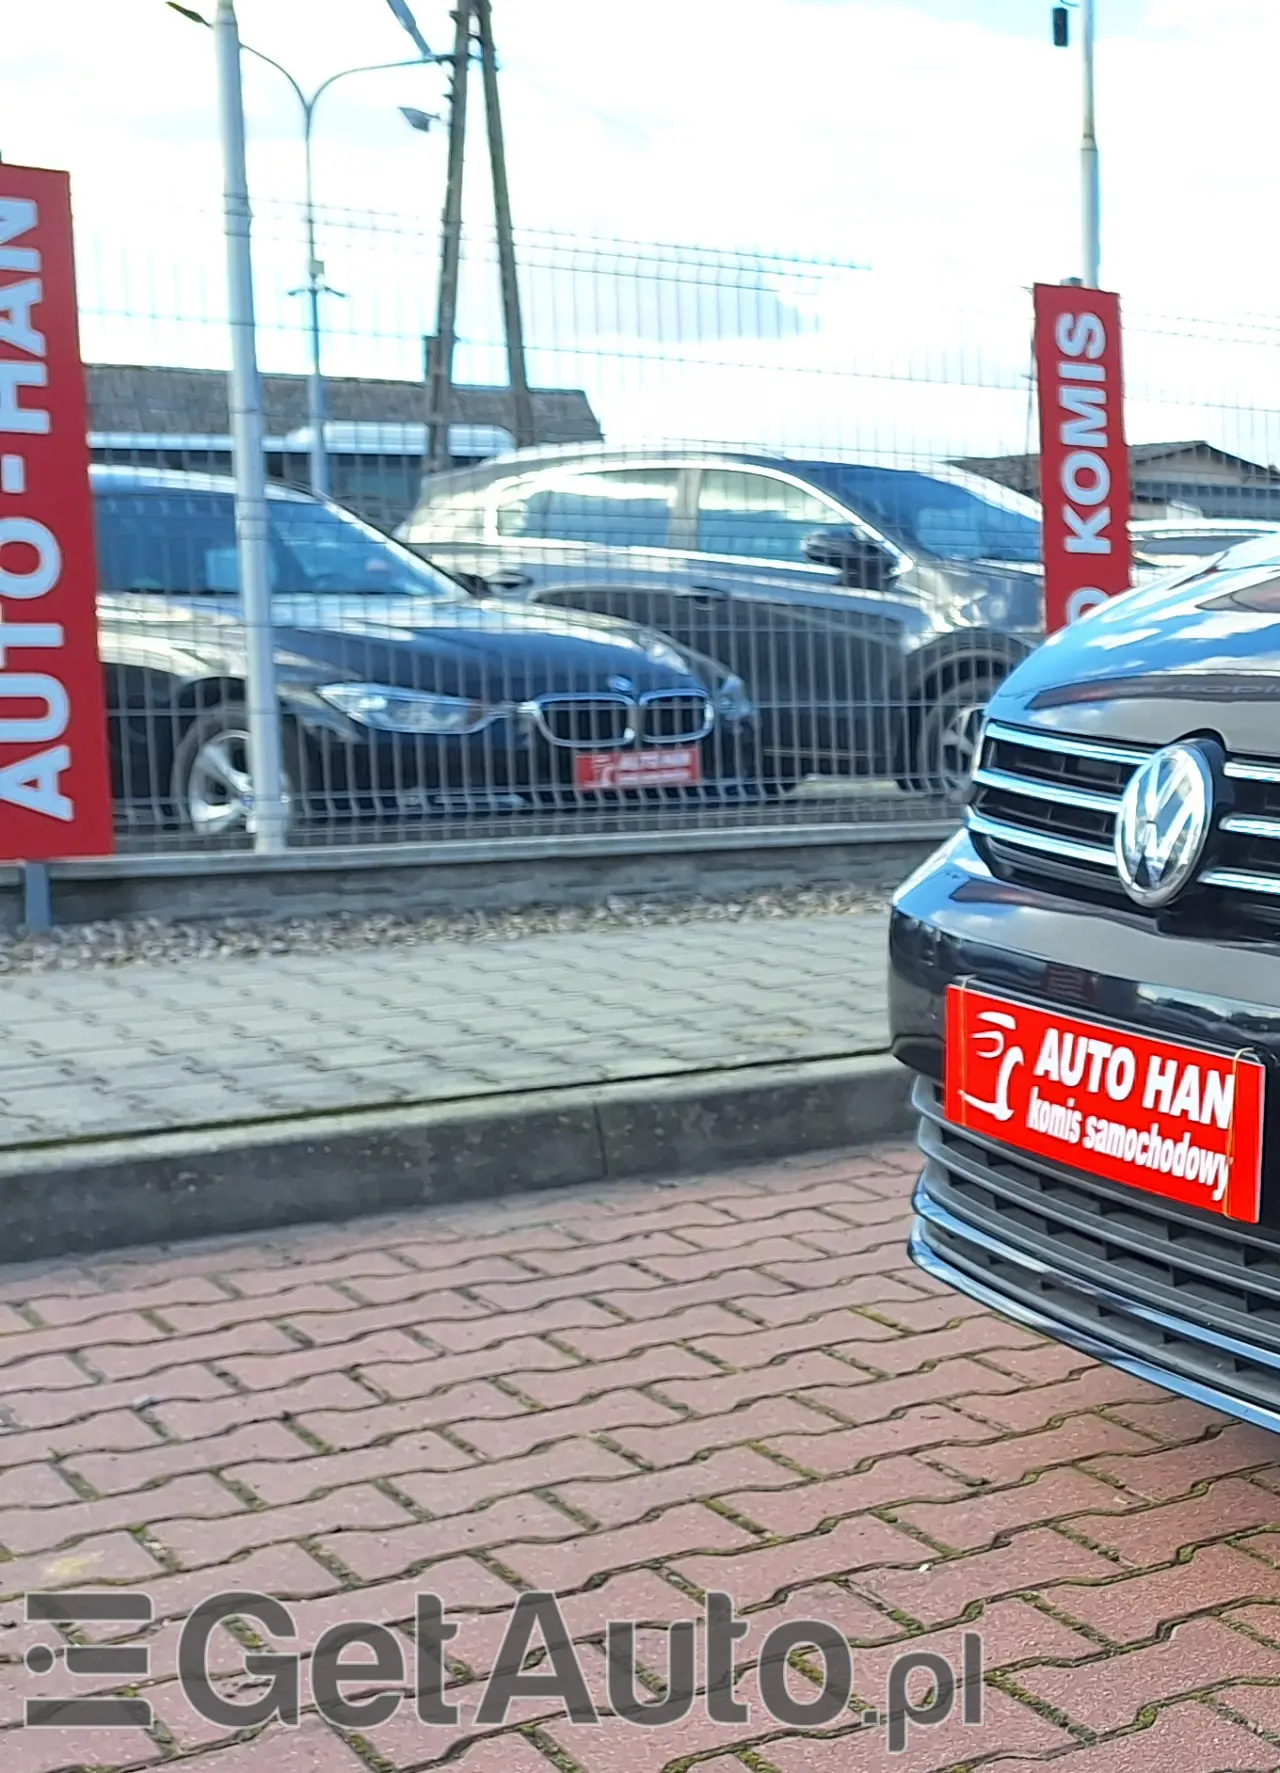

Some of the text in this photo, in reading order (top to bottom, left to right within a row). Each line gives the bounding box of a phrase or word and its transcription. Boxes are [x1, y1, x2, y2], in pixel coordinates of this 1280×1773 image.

[1056, 312, 1111, 554] KOMIS
[1034, 1028, 1234, 1130] AUTO HAN
[1026, 1086, 1231, 1201] komis samochodowy
